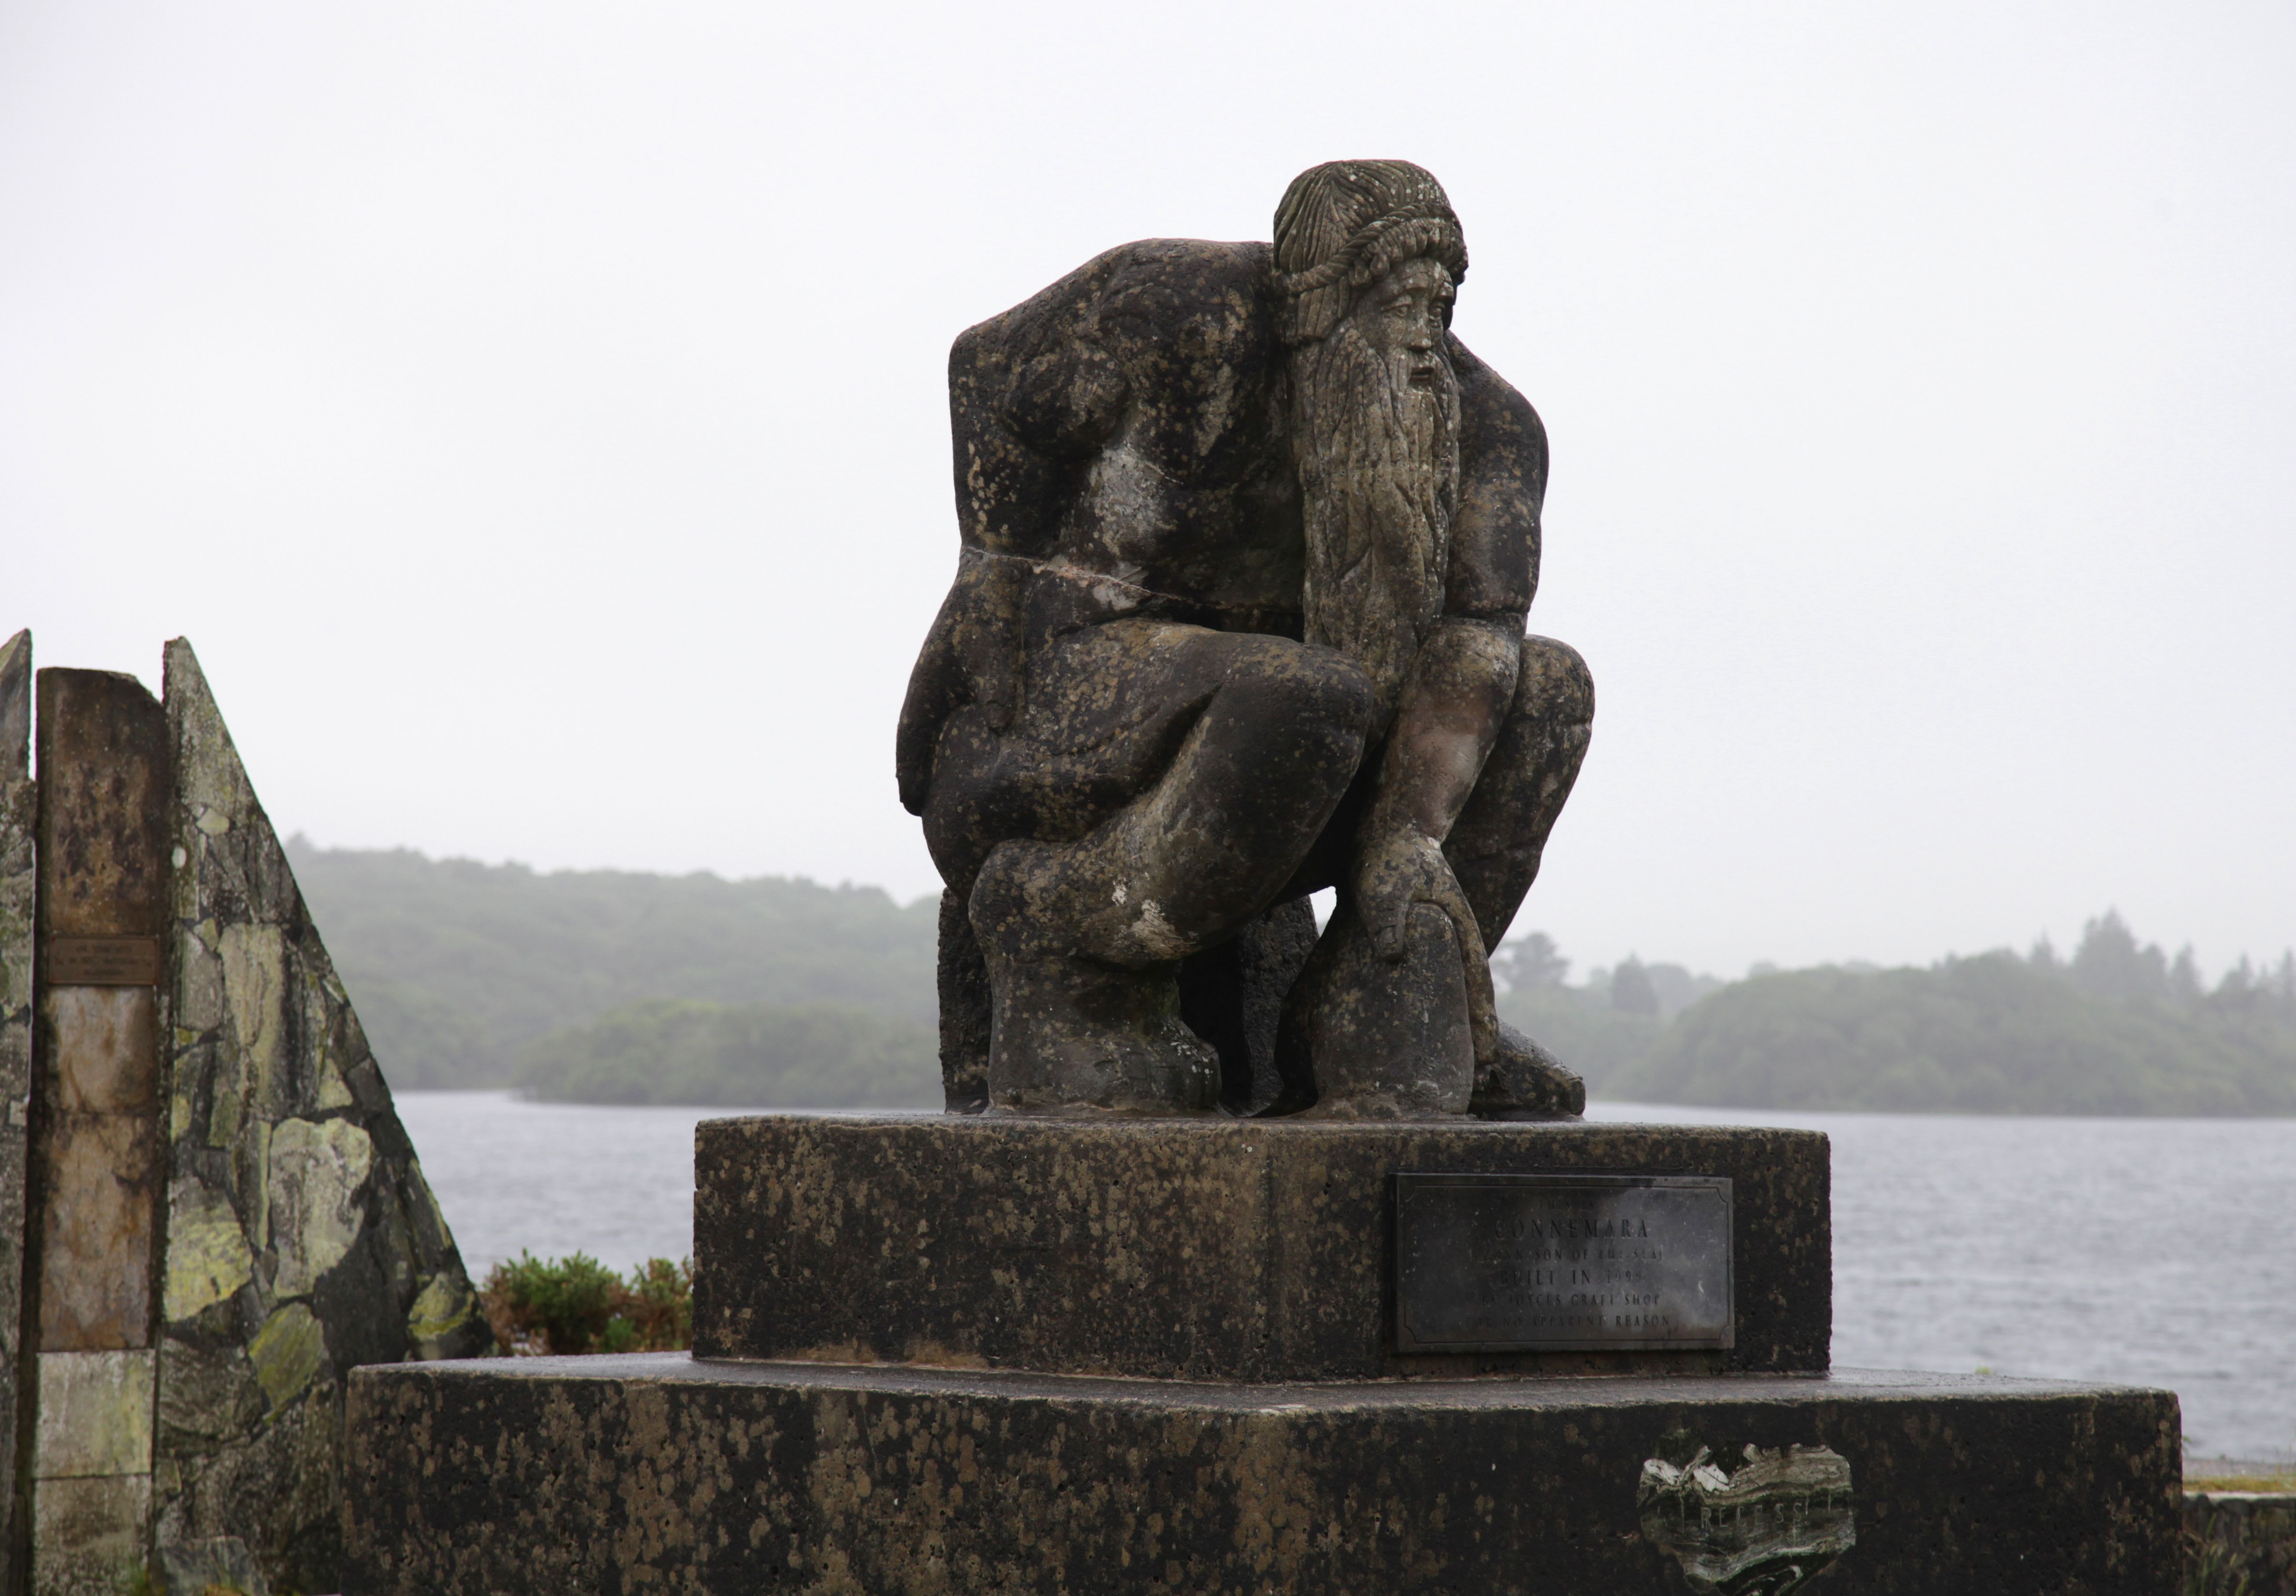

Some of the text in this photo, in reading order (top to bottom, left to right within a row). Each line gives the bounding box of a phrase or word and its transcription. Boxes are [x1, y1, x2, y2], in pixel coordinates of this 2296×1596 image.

[1539, 1200, 1594, 1210] THIS IS
[1495, 1219, 1648, 1239] CONNEMARA
[1535, 1248, 1562, 1261] SON
[1572, 1248, 1589, 1260] OF
[1501, 1269, 1642, 1285] BUILT IN 1999
[1482, 1293, 1660, 1306] BY JOYCES CRAFT SHOP
[1466, 1314, 1670, 1328] FOR NO APPARENT REASON
[1700, 1502, 1803, 1529] RECESS
